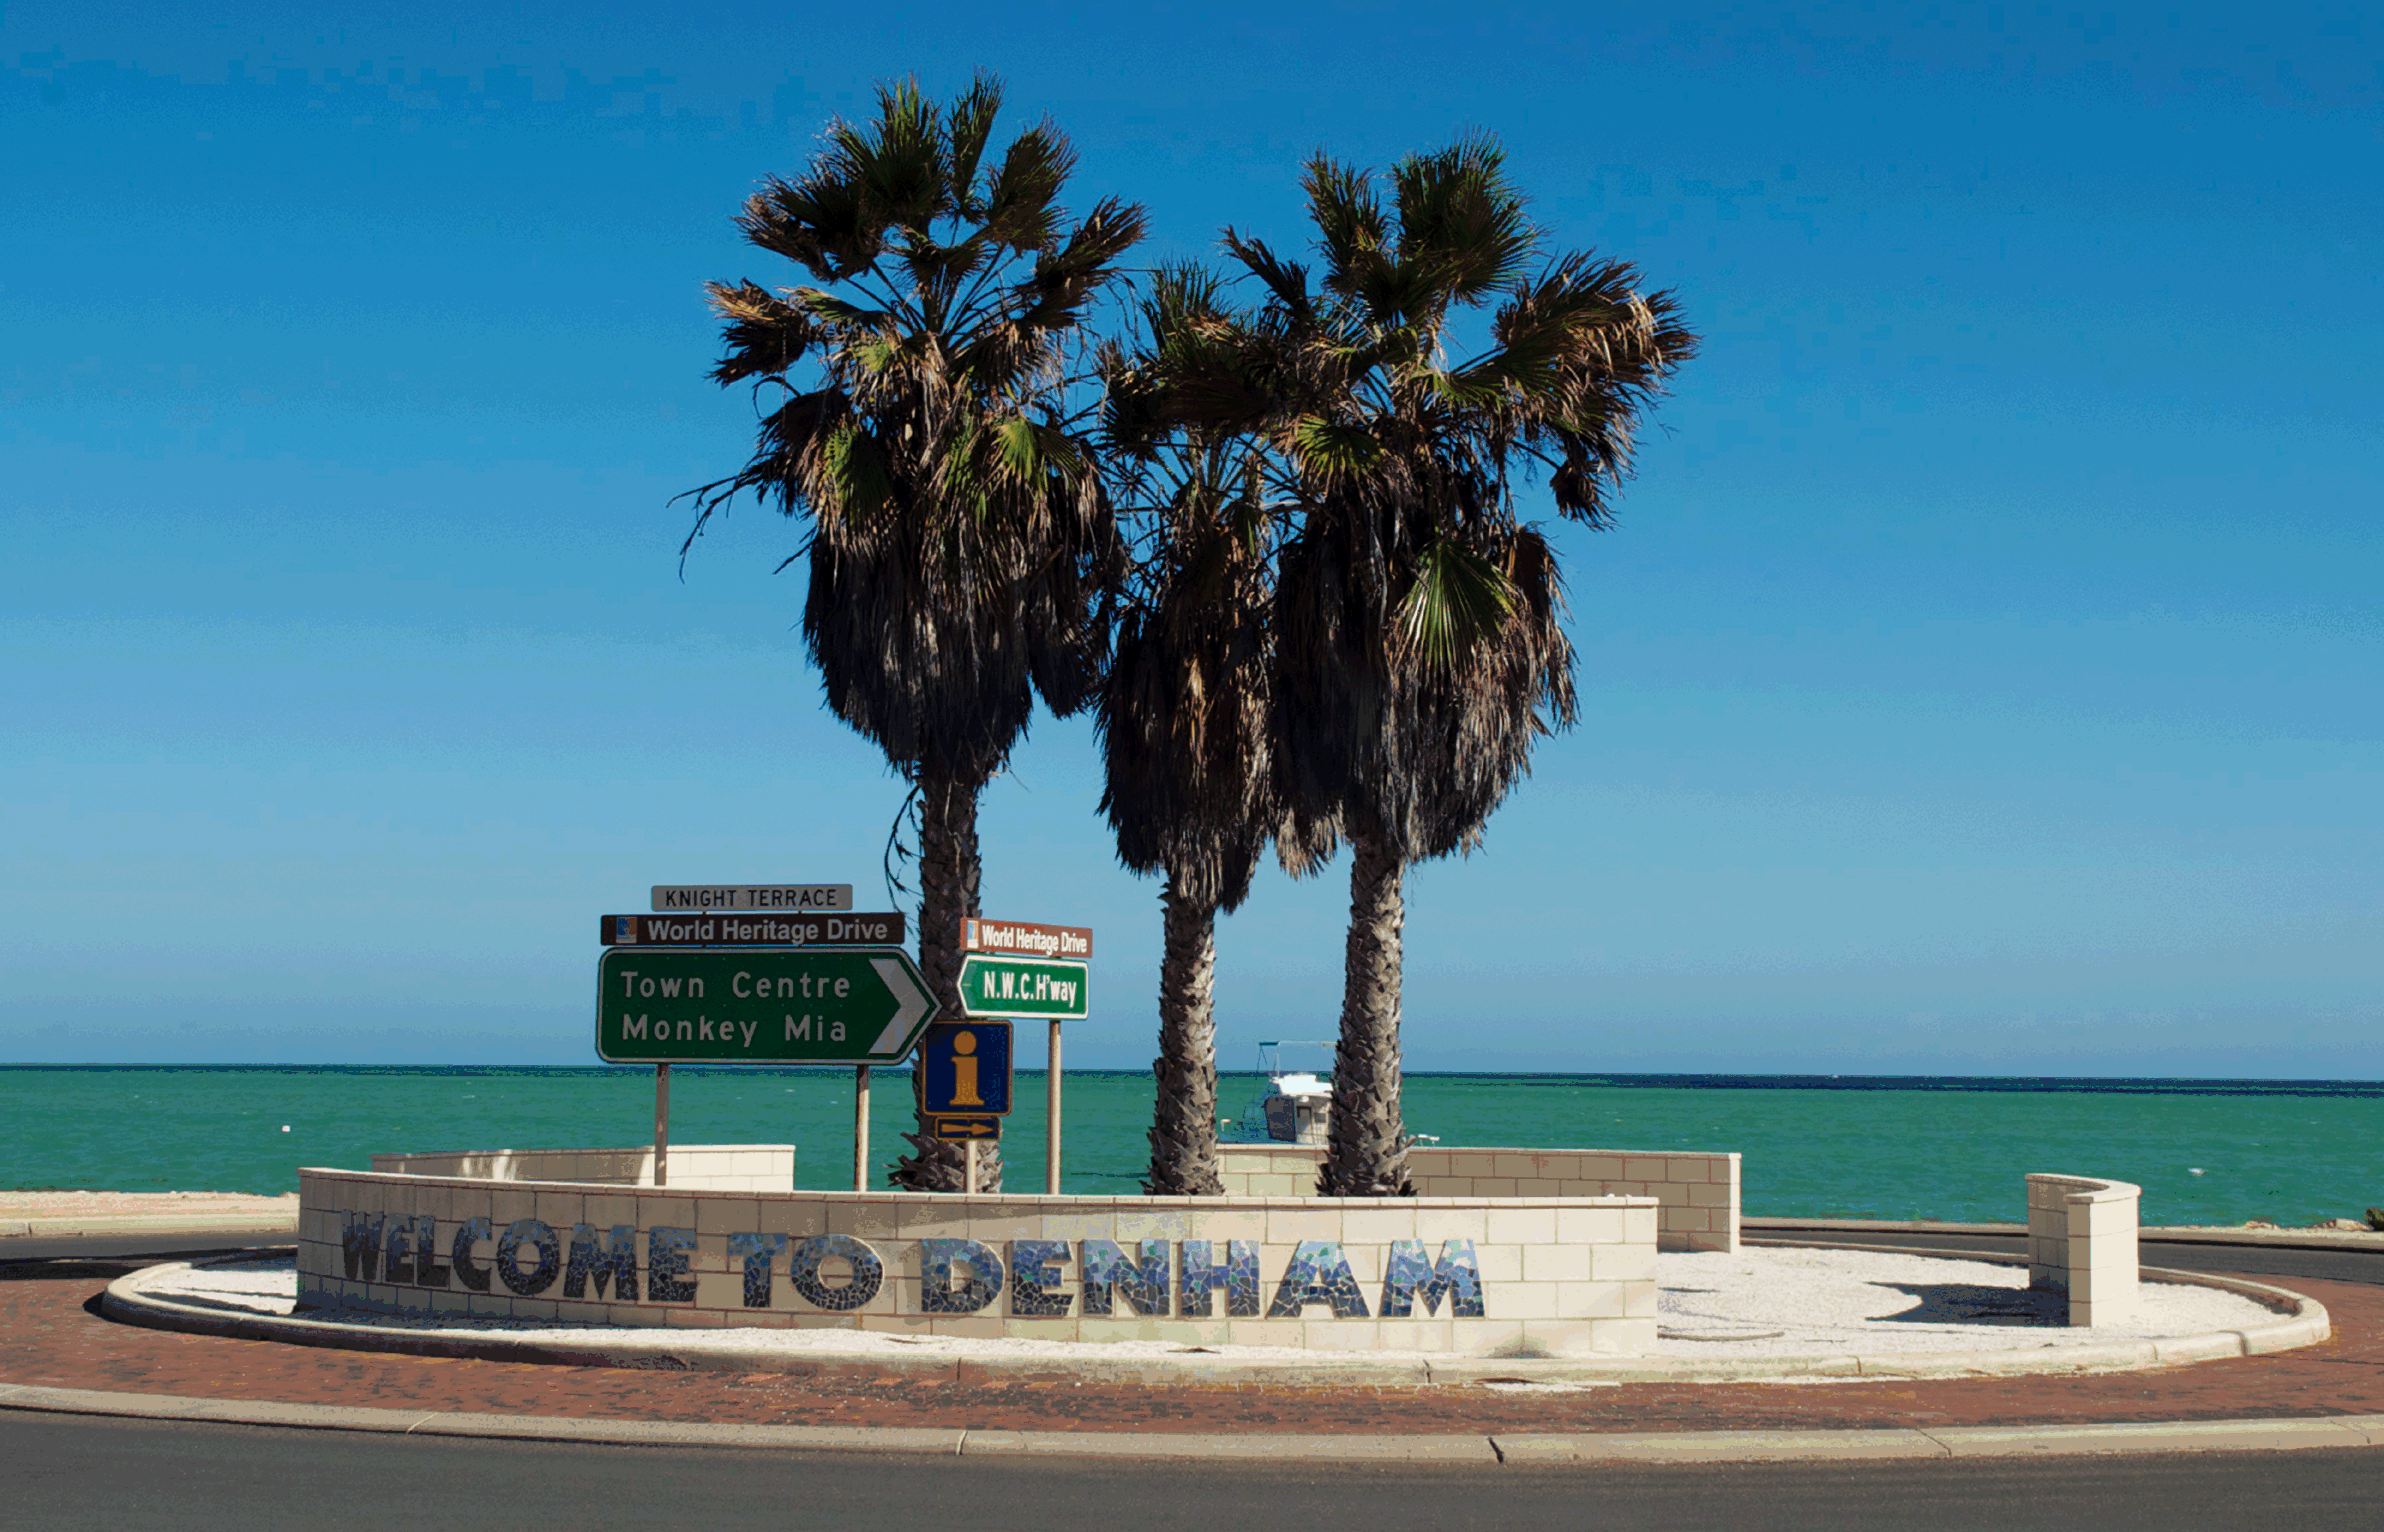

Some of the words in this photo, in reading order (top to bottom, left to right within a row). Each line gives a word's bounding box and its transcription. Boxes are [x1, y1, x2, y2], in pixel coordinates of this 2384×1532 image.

[665, 889, 737, 907] KNIGHT
[747, 888, 837, 906] TERRACE
[647, 919, 714, 941] World
[722, 918, 819, 946] Heritage
[827, 918, 888, 939] Drive
[982, 924, 1014, 947] World
[1016, 928, 1059, 955] Heritage
[1061, 931, 1088, 953] Drive
[621, 971, 704, 998] Town
[732, 971, 850, 998] Centre
[622, 1013, 758, 1047] Monkey
[785, 1014, 846, 1041] Mia
[341, 1208, 698, 1302] WELCOME
[726, 1230, 885, 1311] TO
[920, 1238, 1486, 1318] DENHAM
